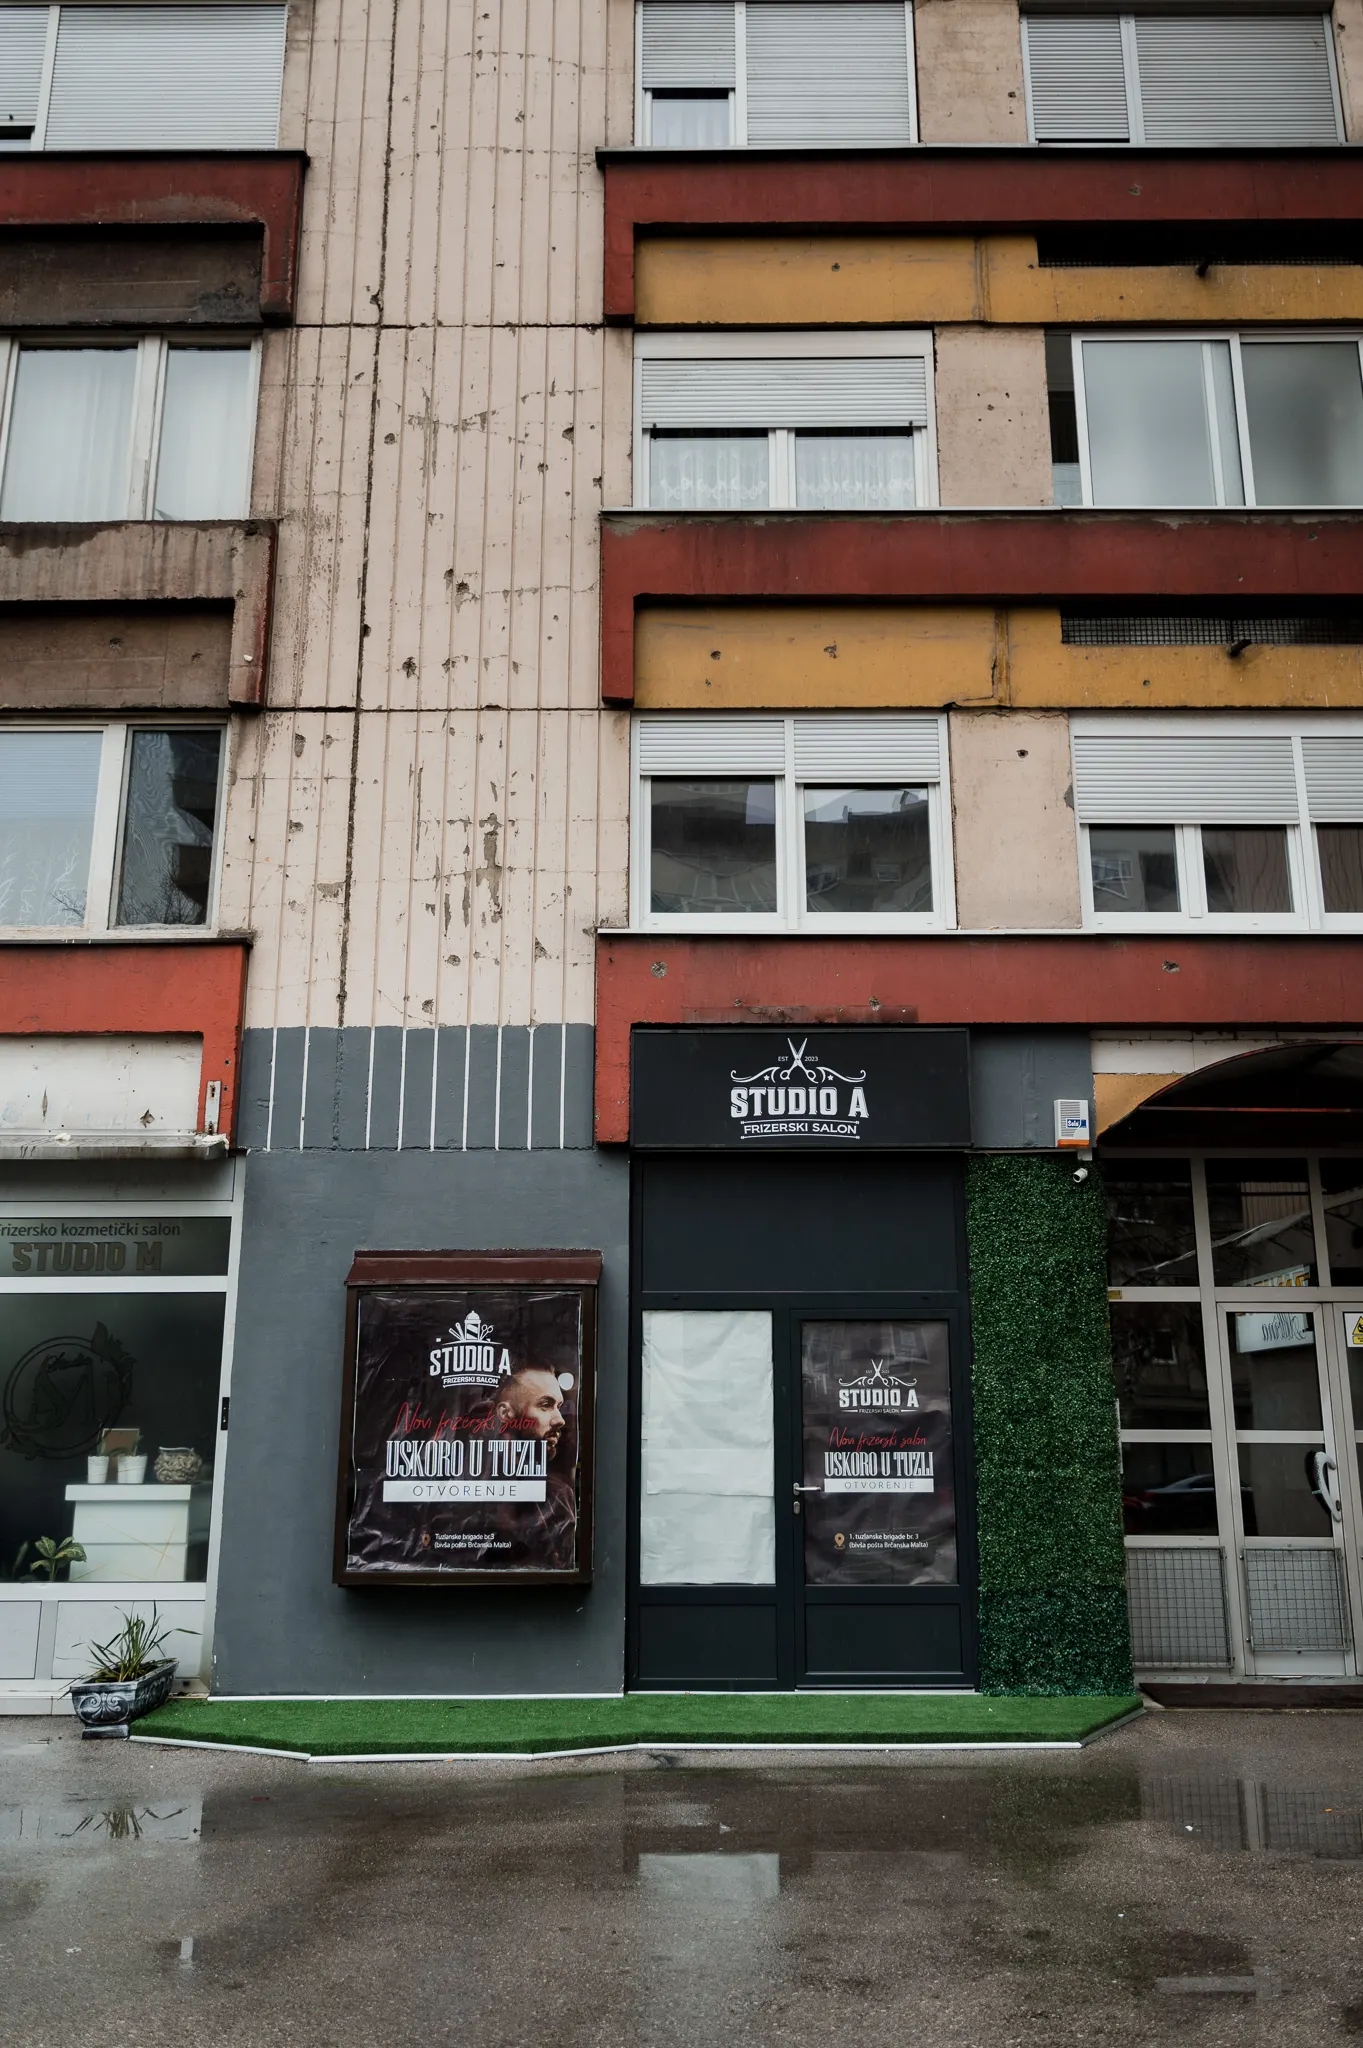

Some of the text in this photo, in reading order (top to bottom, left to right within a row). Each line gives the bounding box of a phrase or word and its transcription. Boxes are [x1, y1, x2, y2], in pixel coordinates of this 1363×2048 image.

[730, 1087, 869, 1118] STUDIO A
[744, 1123, 857, 1134] FRIZERSKI SALON
[61, 1222, 138, 1236] kozmetički
[142, 1222, 180, 1236] salon
[9, 1241, 163, 1272] STUDIO M
[430, 1346, 511, 1376] STUDIO A
[839, 1389, 919, 1407] STUDIO A
[394, 1402, 539, 1441] Novi frizerski salon
[829, 1426, 926, 1452] Novi frizerski salon
[386, 1440, 548, 1477] USKORO U TUZLI
[824, 1452, 934, 1476] USKORO U TUZLI
[413, 1485, 517, 1497] OTVORENJE
[844, 1481, 915, 1489] OTVORENJE
